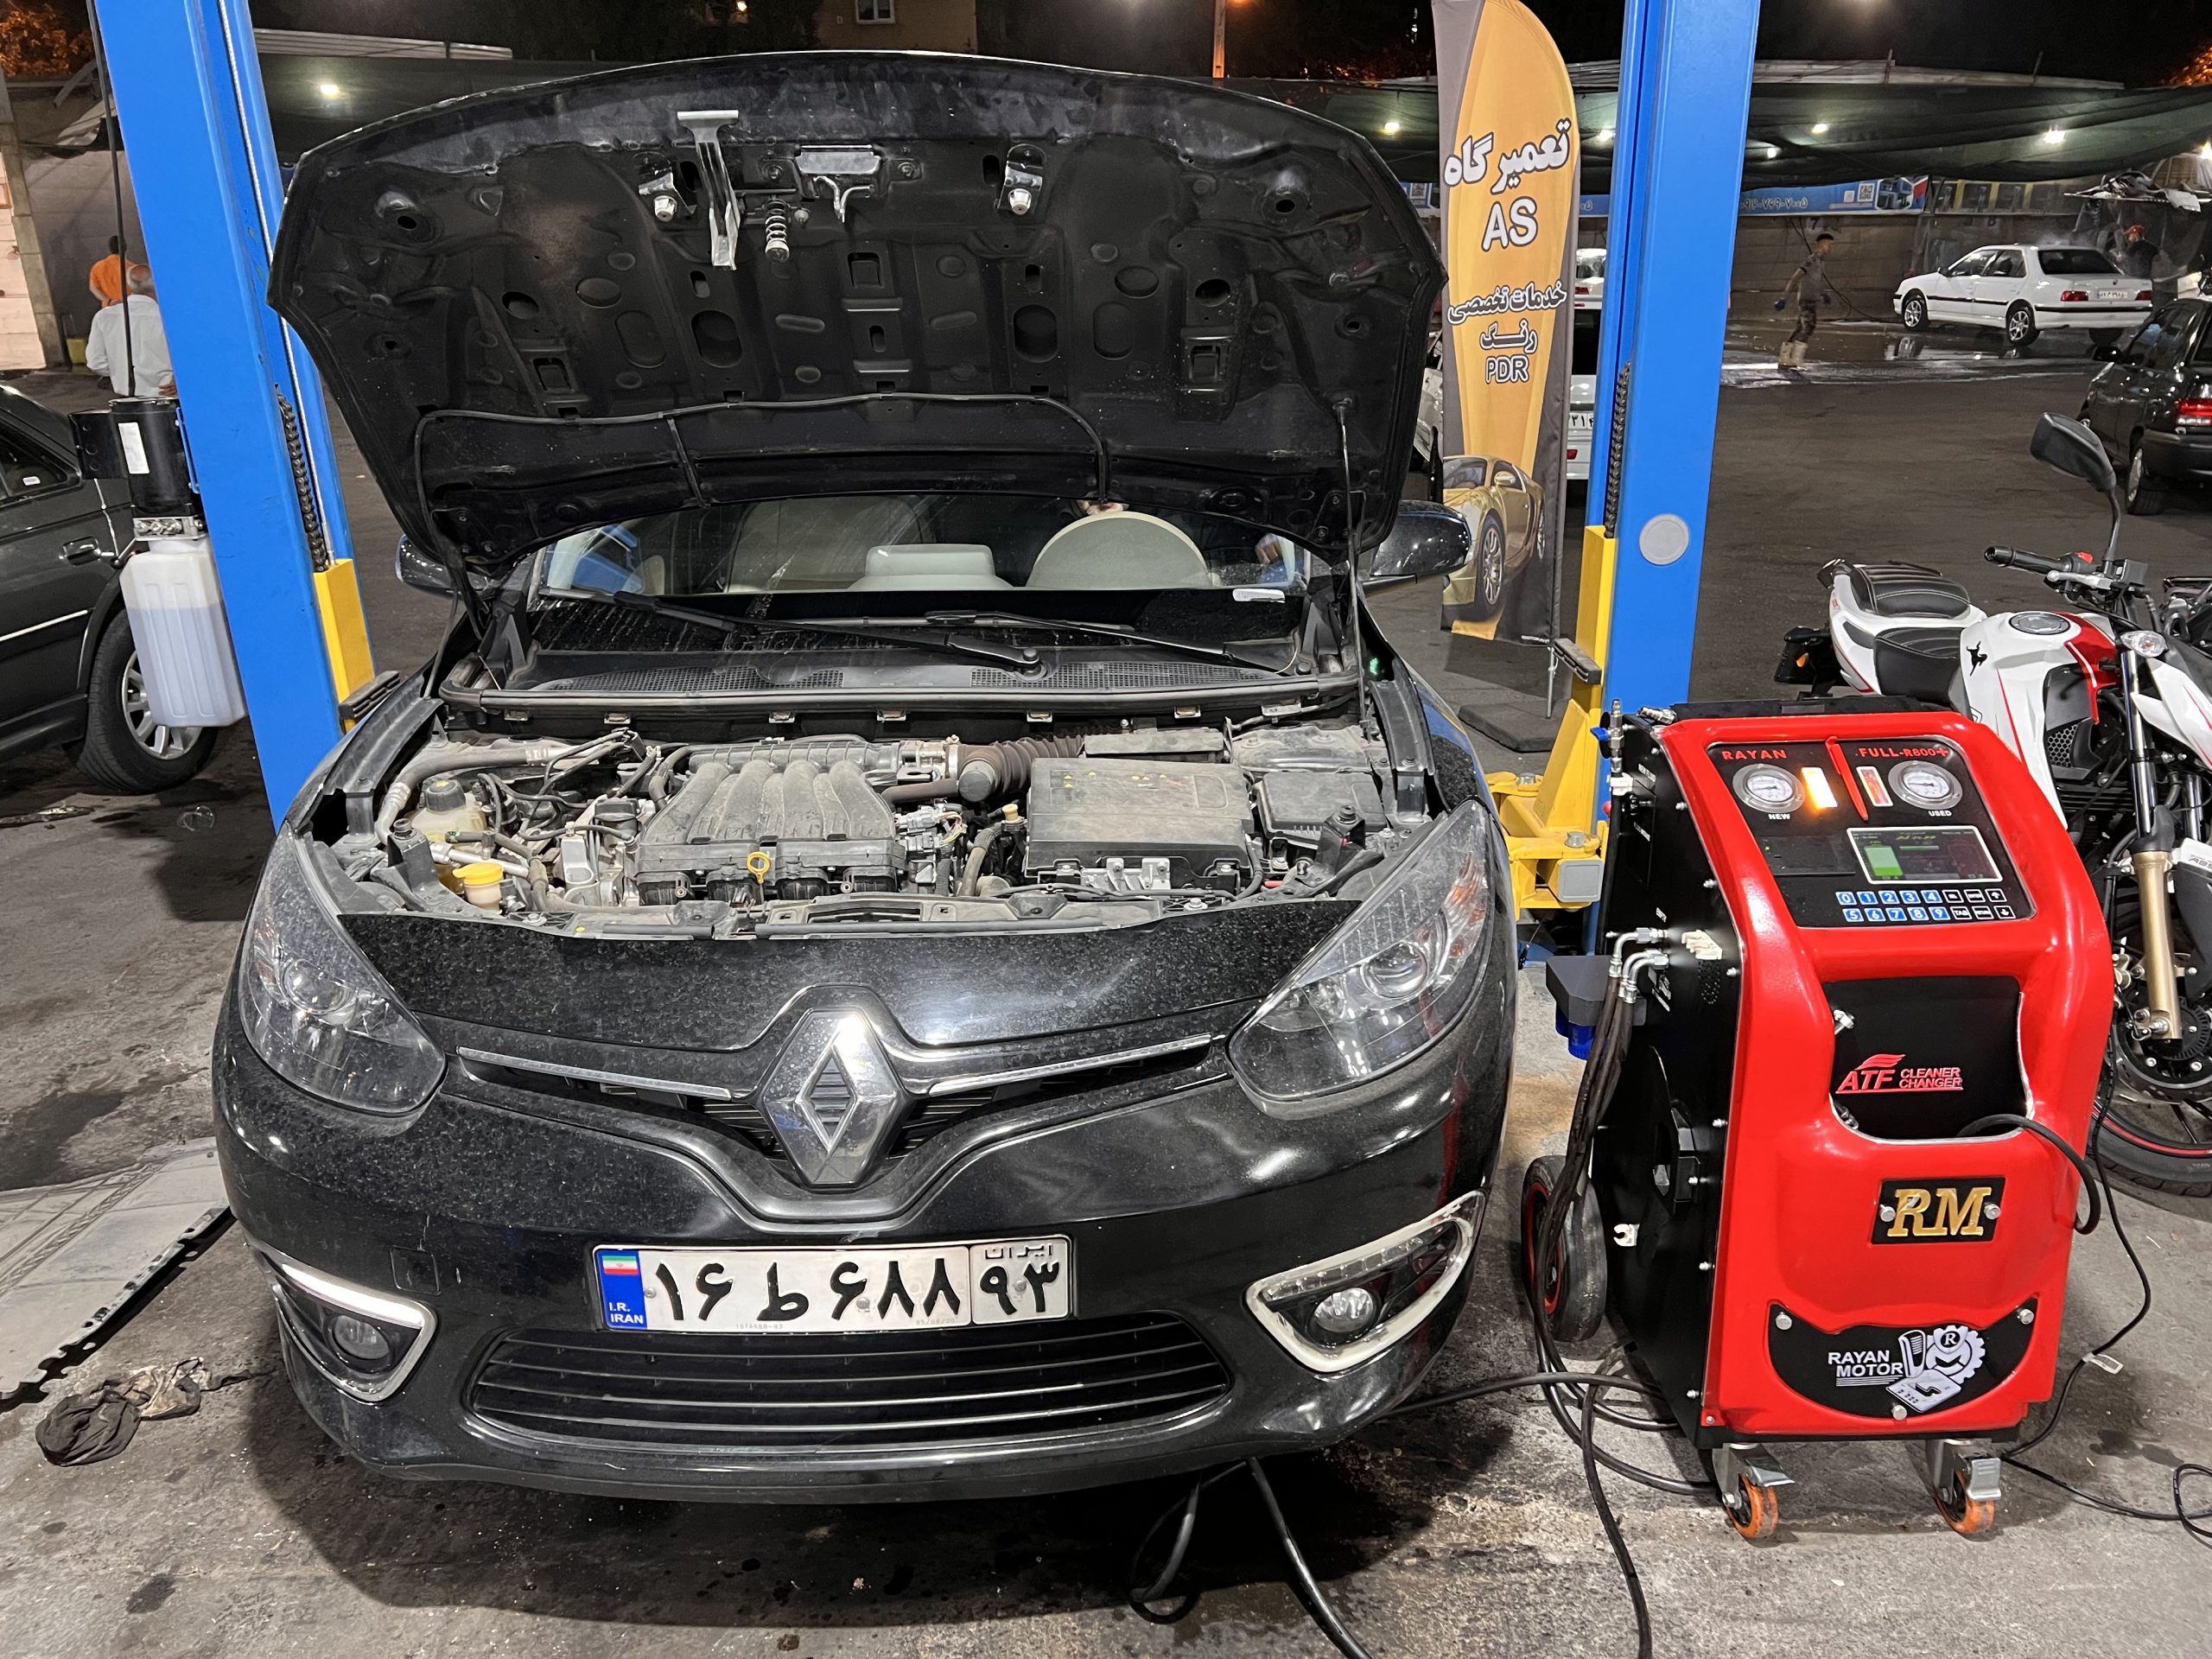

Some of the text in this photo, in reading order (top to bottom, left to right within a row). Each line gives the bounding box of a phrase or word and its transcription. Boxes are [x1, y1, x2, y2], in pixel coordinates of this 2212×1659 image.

[1481, 196, 1539, 251] AS
[1447, 279, 1567, 325] خدمات تخصصی
[1485, 354, 1529, 385] PDR
[1721, 749, 1788, 760] RAYAN
[1858, 747, 1948, 759] FULL-R800+
[1841, 894, 1851, 903] 0
[1864, 893, 1872, 903] 1
[1884, 893, 1894, 902] 2
[1905, 893, 1915, 902] 3
[1928, 892, 1936, 901] 4
[1849, 910, 1859, 920] 5
[1872, 910, 1880, 919] 6
[1891, 910, 1899, 919] 7
[1914, 910, 1923, 919] 8
[1935, 909, 1943, 918] 9
[1836, 1068, 1897, 1091] ATF
[1900, 1067, 1961, 1079] CLEANER
[1898, 1077, 1963, 1090] CHANGER
[1886, 1186, 1992, 1237] RM
[984, 1243, 1053, 1260] ایران
[756, 1261, 810, 1321] ط
[830, 1258, 961, 1321] ۶۸۸
[980, 1261, 1059, 1315] ۹۳
[608, 1301, 631, 1313] I.R.
[610, 1313, 644, 1324] IRAN
[1943, 1332, 1956, 1346] R
[1827, 1350, 1891, 1364] RAYAN
[1836, 1362, 1904, 1377] MOTOR
